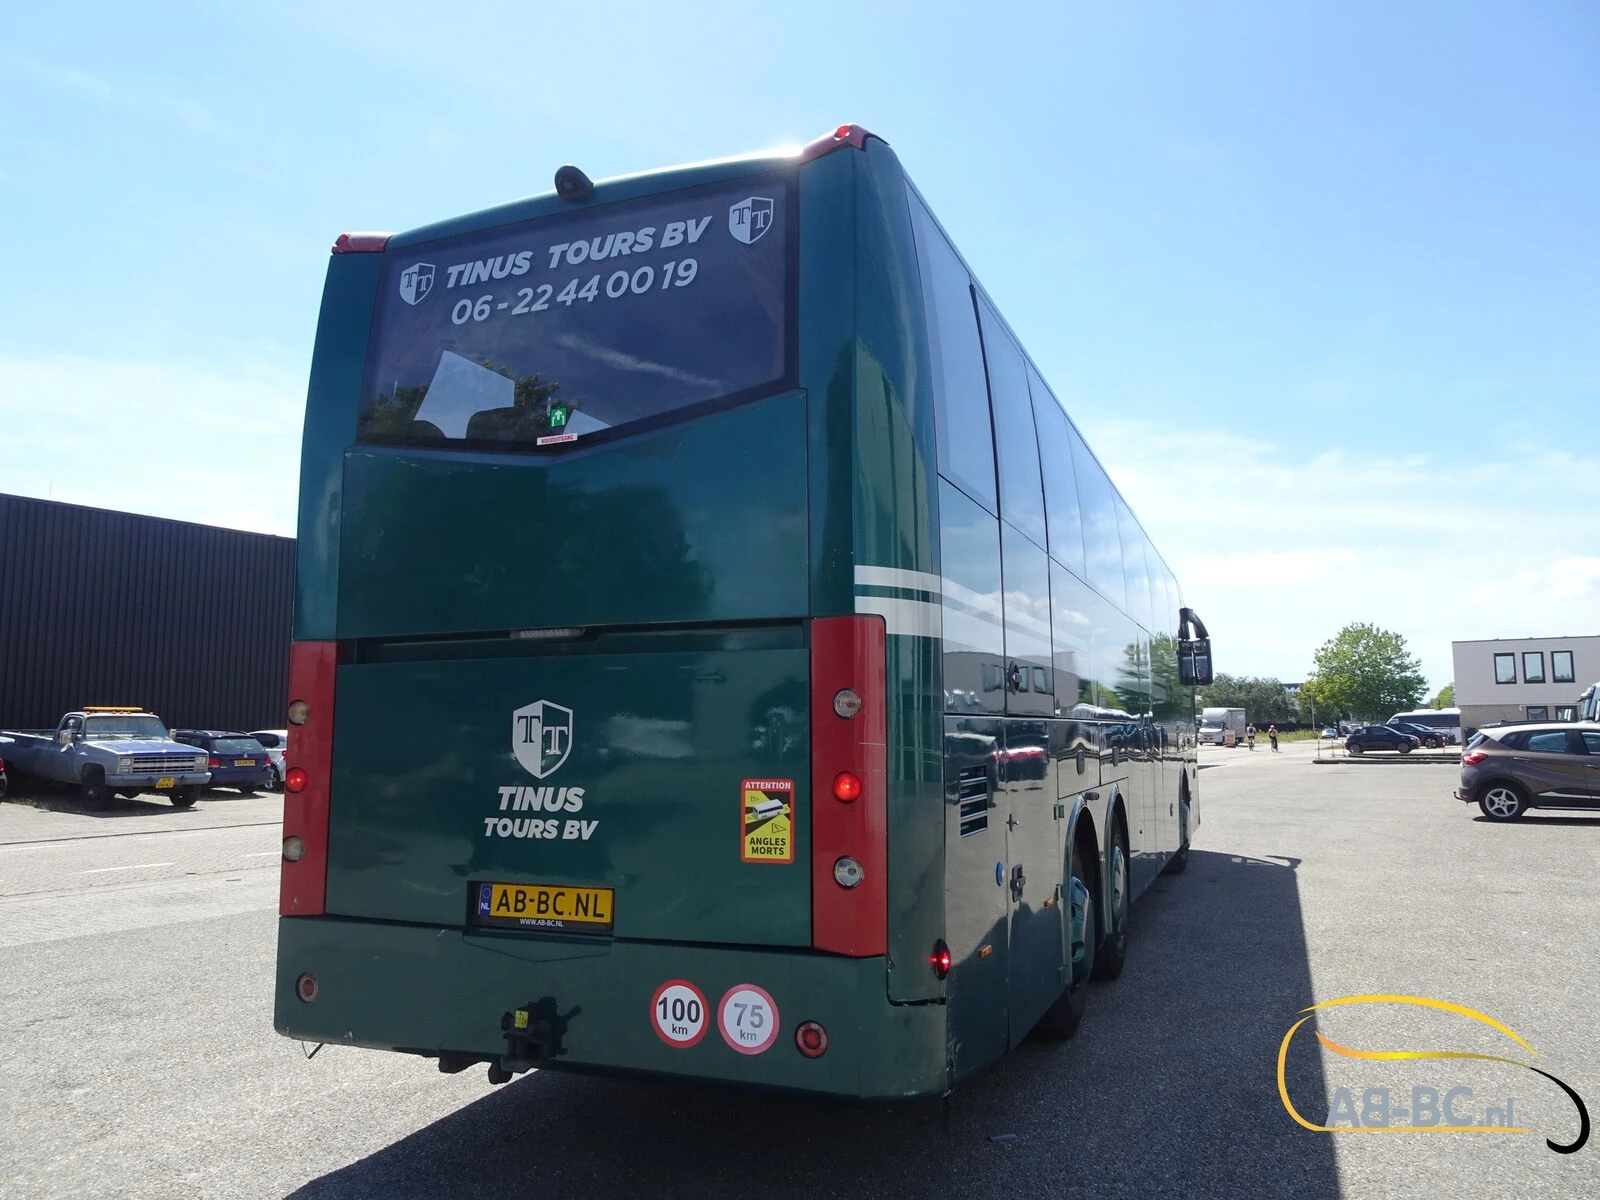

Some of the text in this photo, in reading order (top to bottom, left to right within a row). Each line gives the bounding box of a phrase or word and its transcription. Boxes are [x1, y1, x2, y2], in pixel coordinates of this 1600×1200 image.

[447, 215, 713, 288] TINUS TOURS BV
[451, 294, 493, 325] 06
[661, 258, 698, 289] 19
[517, 715, 569, 755] TT
[498, 786, 586, 813] TINUS
[484, 817, 600, 841] TOURS BV
[749, 837, 786, 846] ANGLES
[751, 846, 785, 855] MORTS
[480, 889, 605, 918] NL AB-BC.NL
[519, 918, 564, 928] WWW.AB-BC.NL
[658, 996, 701, 1024] 100
[733, 1002, 764, 1029] 75
[671, 1023, 688, 1036] km
[739, 1029, 757, 1042] km
